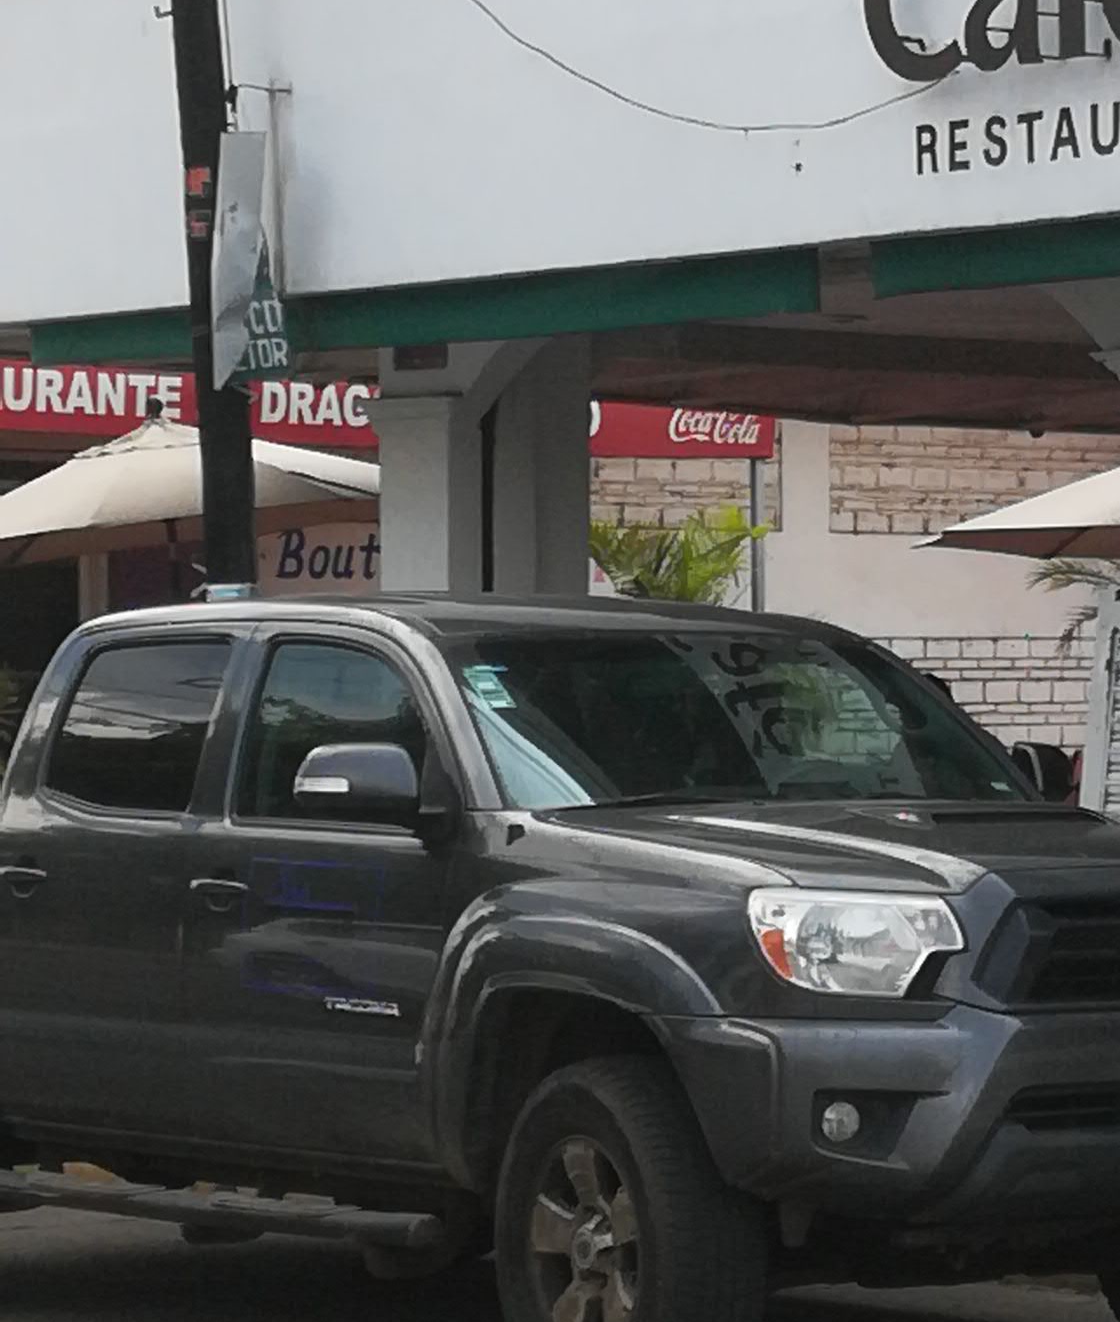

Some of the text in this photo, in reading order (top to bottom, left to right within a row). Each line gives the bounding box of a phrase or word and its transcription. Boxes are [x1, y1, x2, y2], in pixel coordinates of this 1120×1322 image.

[247, 299, 283, 335] CO
[236, 337, 288, 371] TOR
[0, 367, 381, 427] URANTE DRAC
[276, 528, 380, 579] Bout
